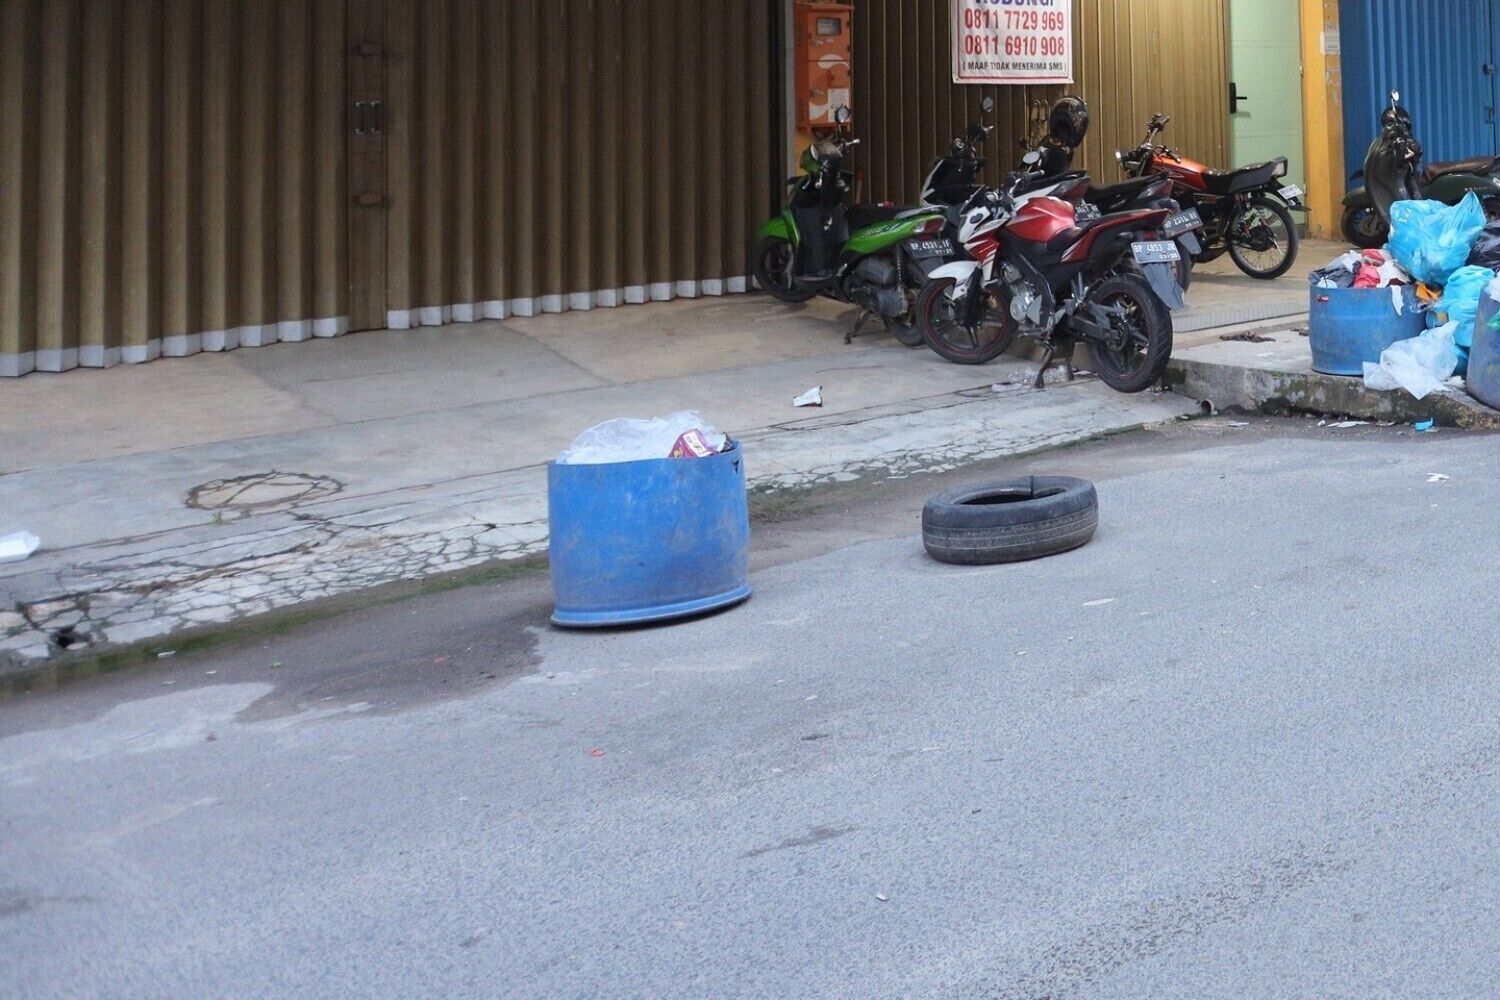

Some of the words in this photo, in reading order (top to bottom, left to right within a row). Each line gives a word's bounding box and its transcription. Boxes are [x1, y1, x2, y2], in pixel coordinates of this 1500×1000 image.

[965, 8, 999, 29] 0811
[1004, 10, 1038, 31] 7729
[1042, 11, 1064, 31] 969
[965, 34, 999, 55] 0811
[1005, 36, 1037, 56] 6910
[1041, 36, 1064, 56] 908
[968, 61, 988, 71] MAAF
[990, 61, 1010, 71] TIDAK
[1012, 61, 1047, 71] MENERIMA
[1049, 62, 1063, 71] SMS
